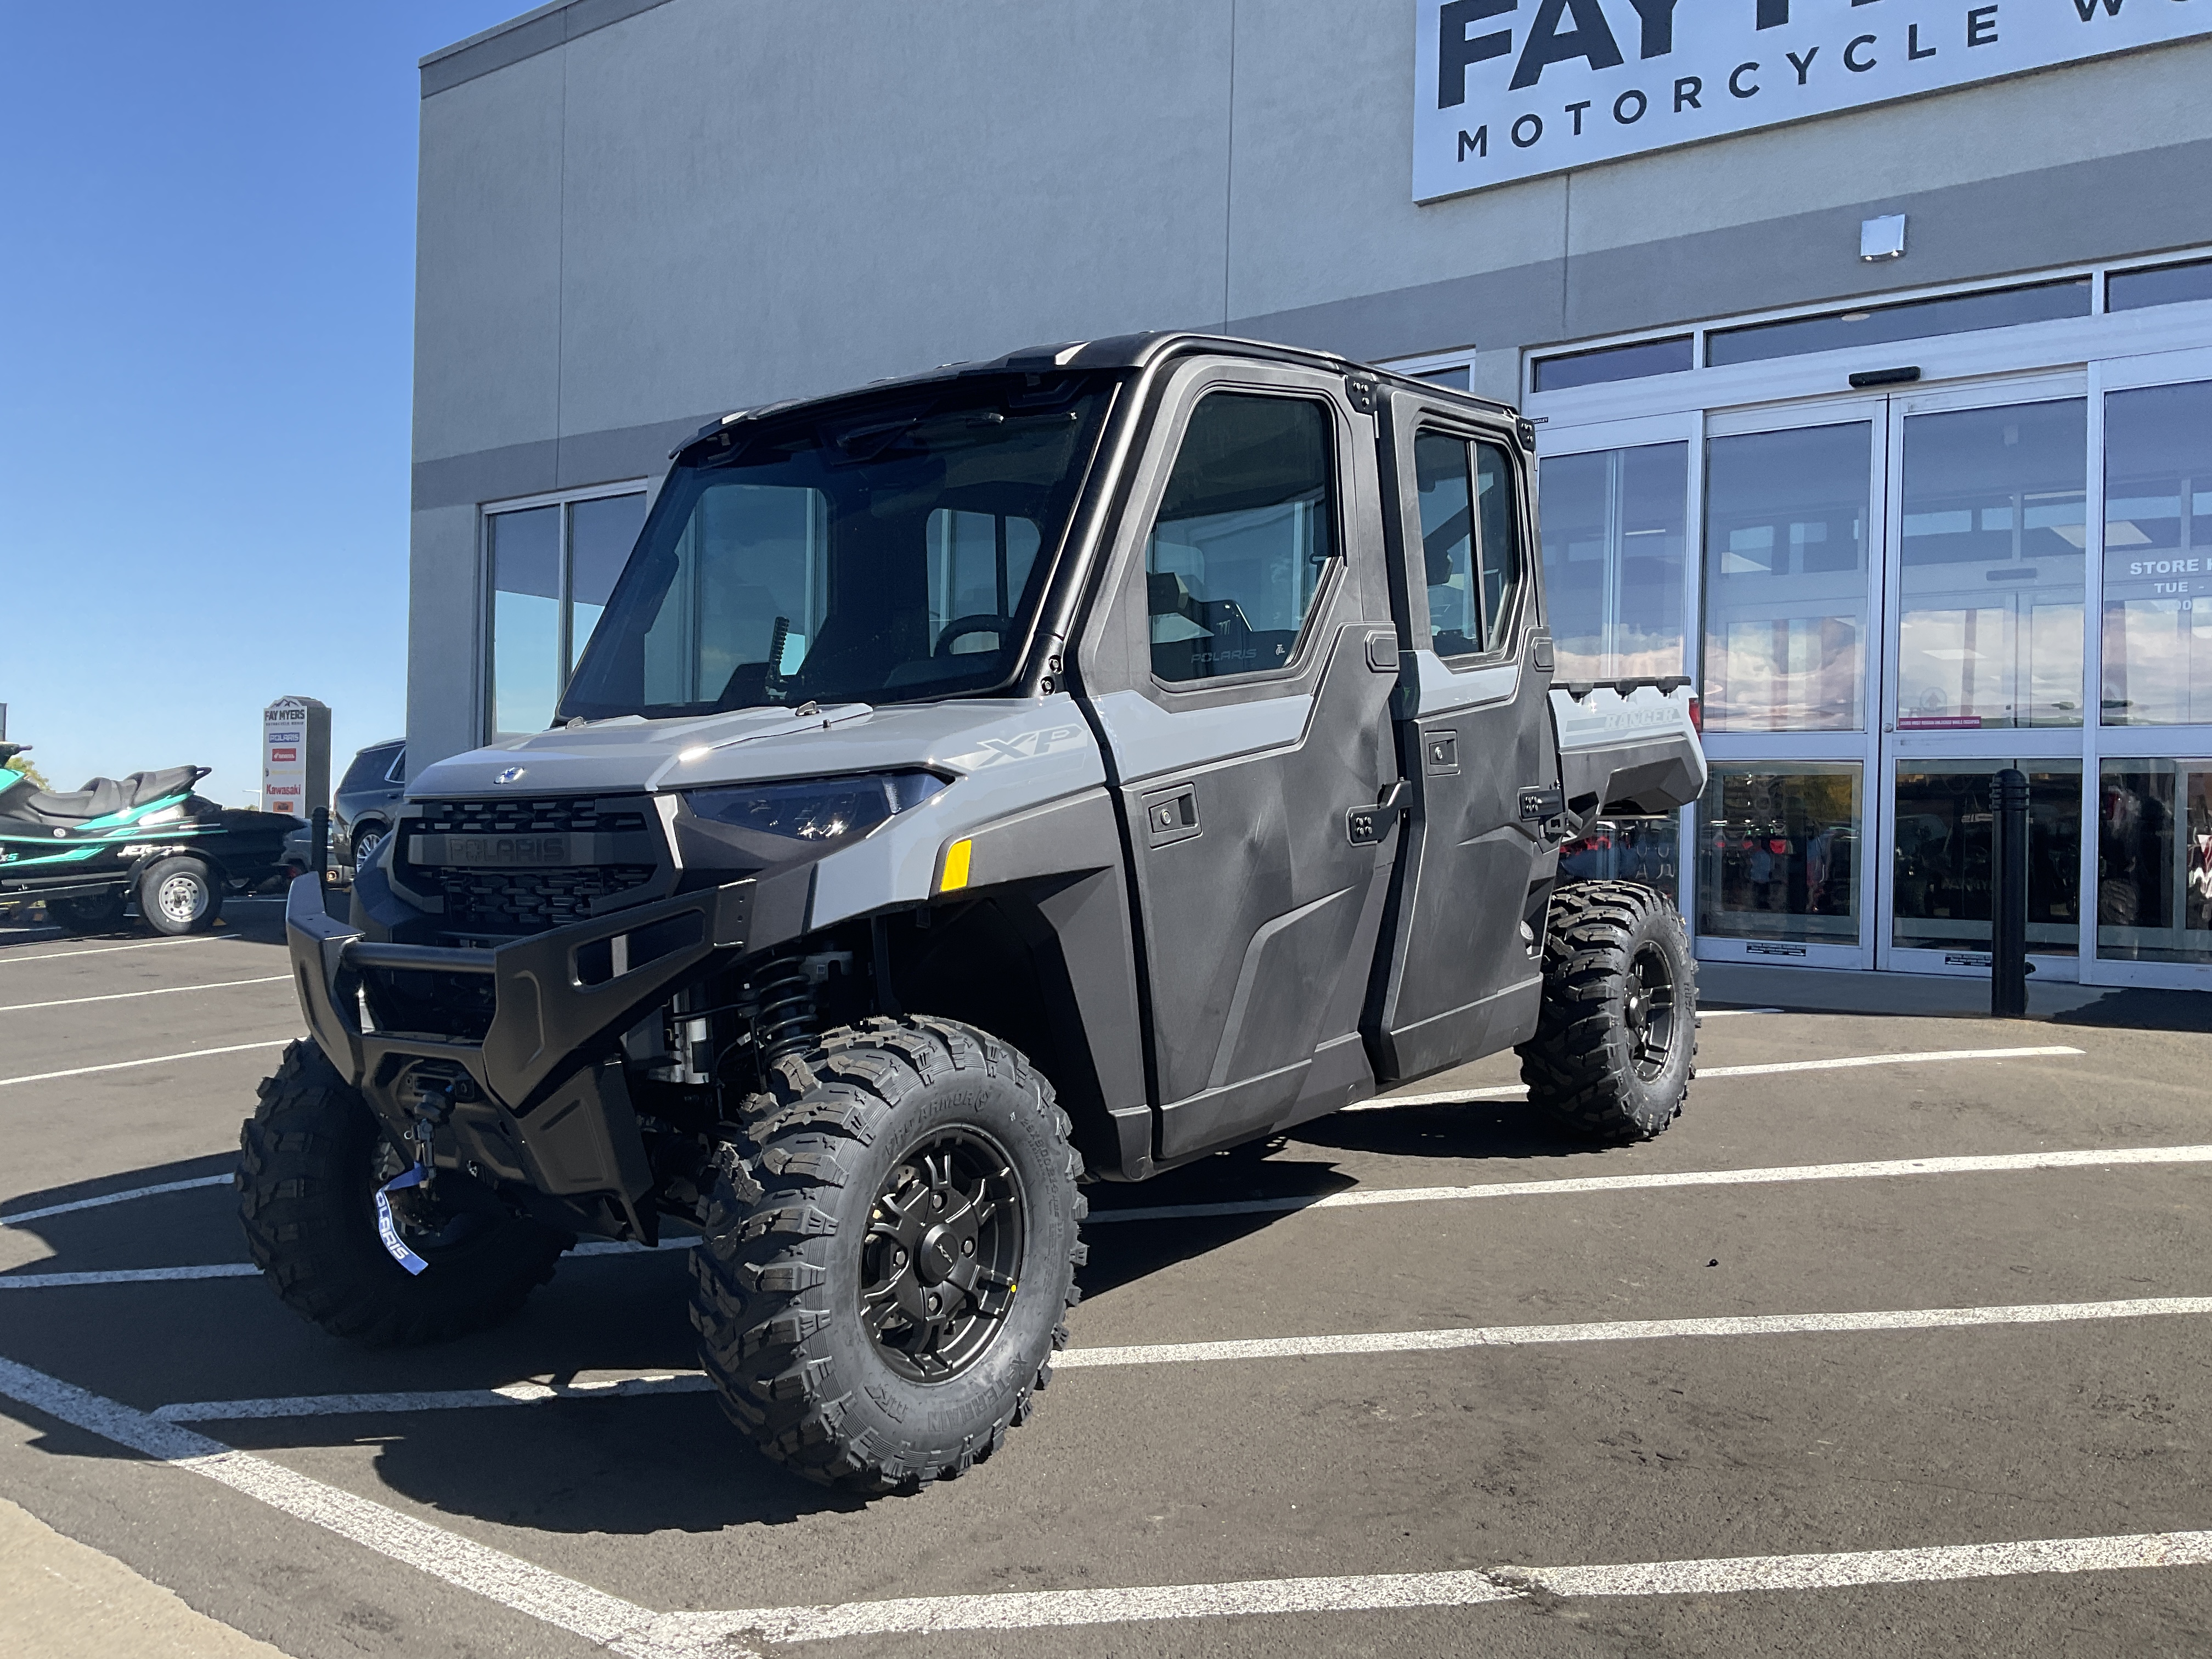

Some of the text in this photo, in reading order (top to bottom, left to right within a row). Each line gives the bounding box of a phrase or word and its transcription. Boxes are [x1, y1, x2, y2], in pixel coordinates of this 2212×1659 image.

[1438, 0, 1678, 109] FAY
[1458, 5, 1999, 162] MOTORCYCLE
[2130, 558, 2199, 575] STORE
[2154, 582, 2188, 594] TUE
[1191, 648, 1257, 663] POLARIS
[265, 708, 304, 721] FAY MYERS
[1604, 707, 1674, 731] RANGER
[976, 723, 1085, 769] XP
[267, 783, 301, 795] Kawasaki
[450, 838, 565, 862] POLARIS
[375, 1190, 409, 1260] OLARIS
[928, 1351, 1029, 1432] X-TERRAIN
